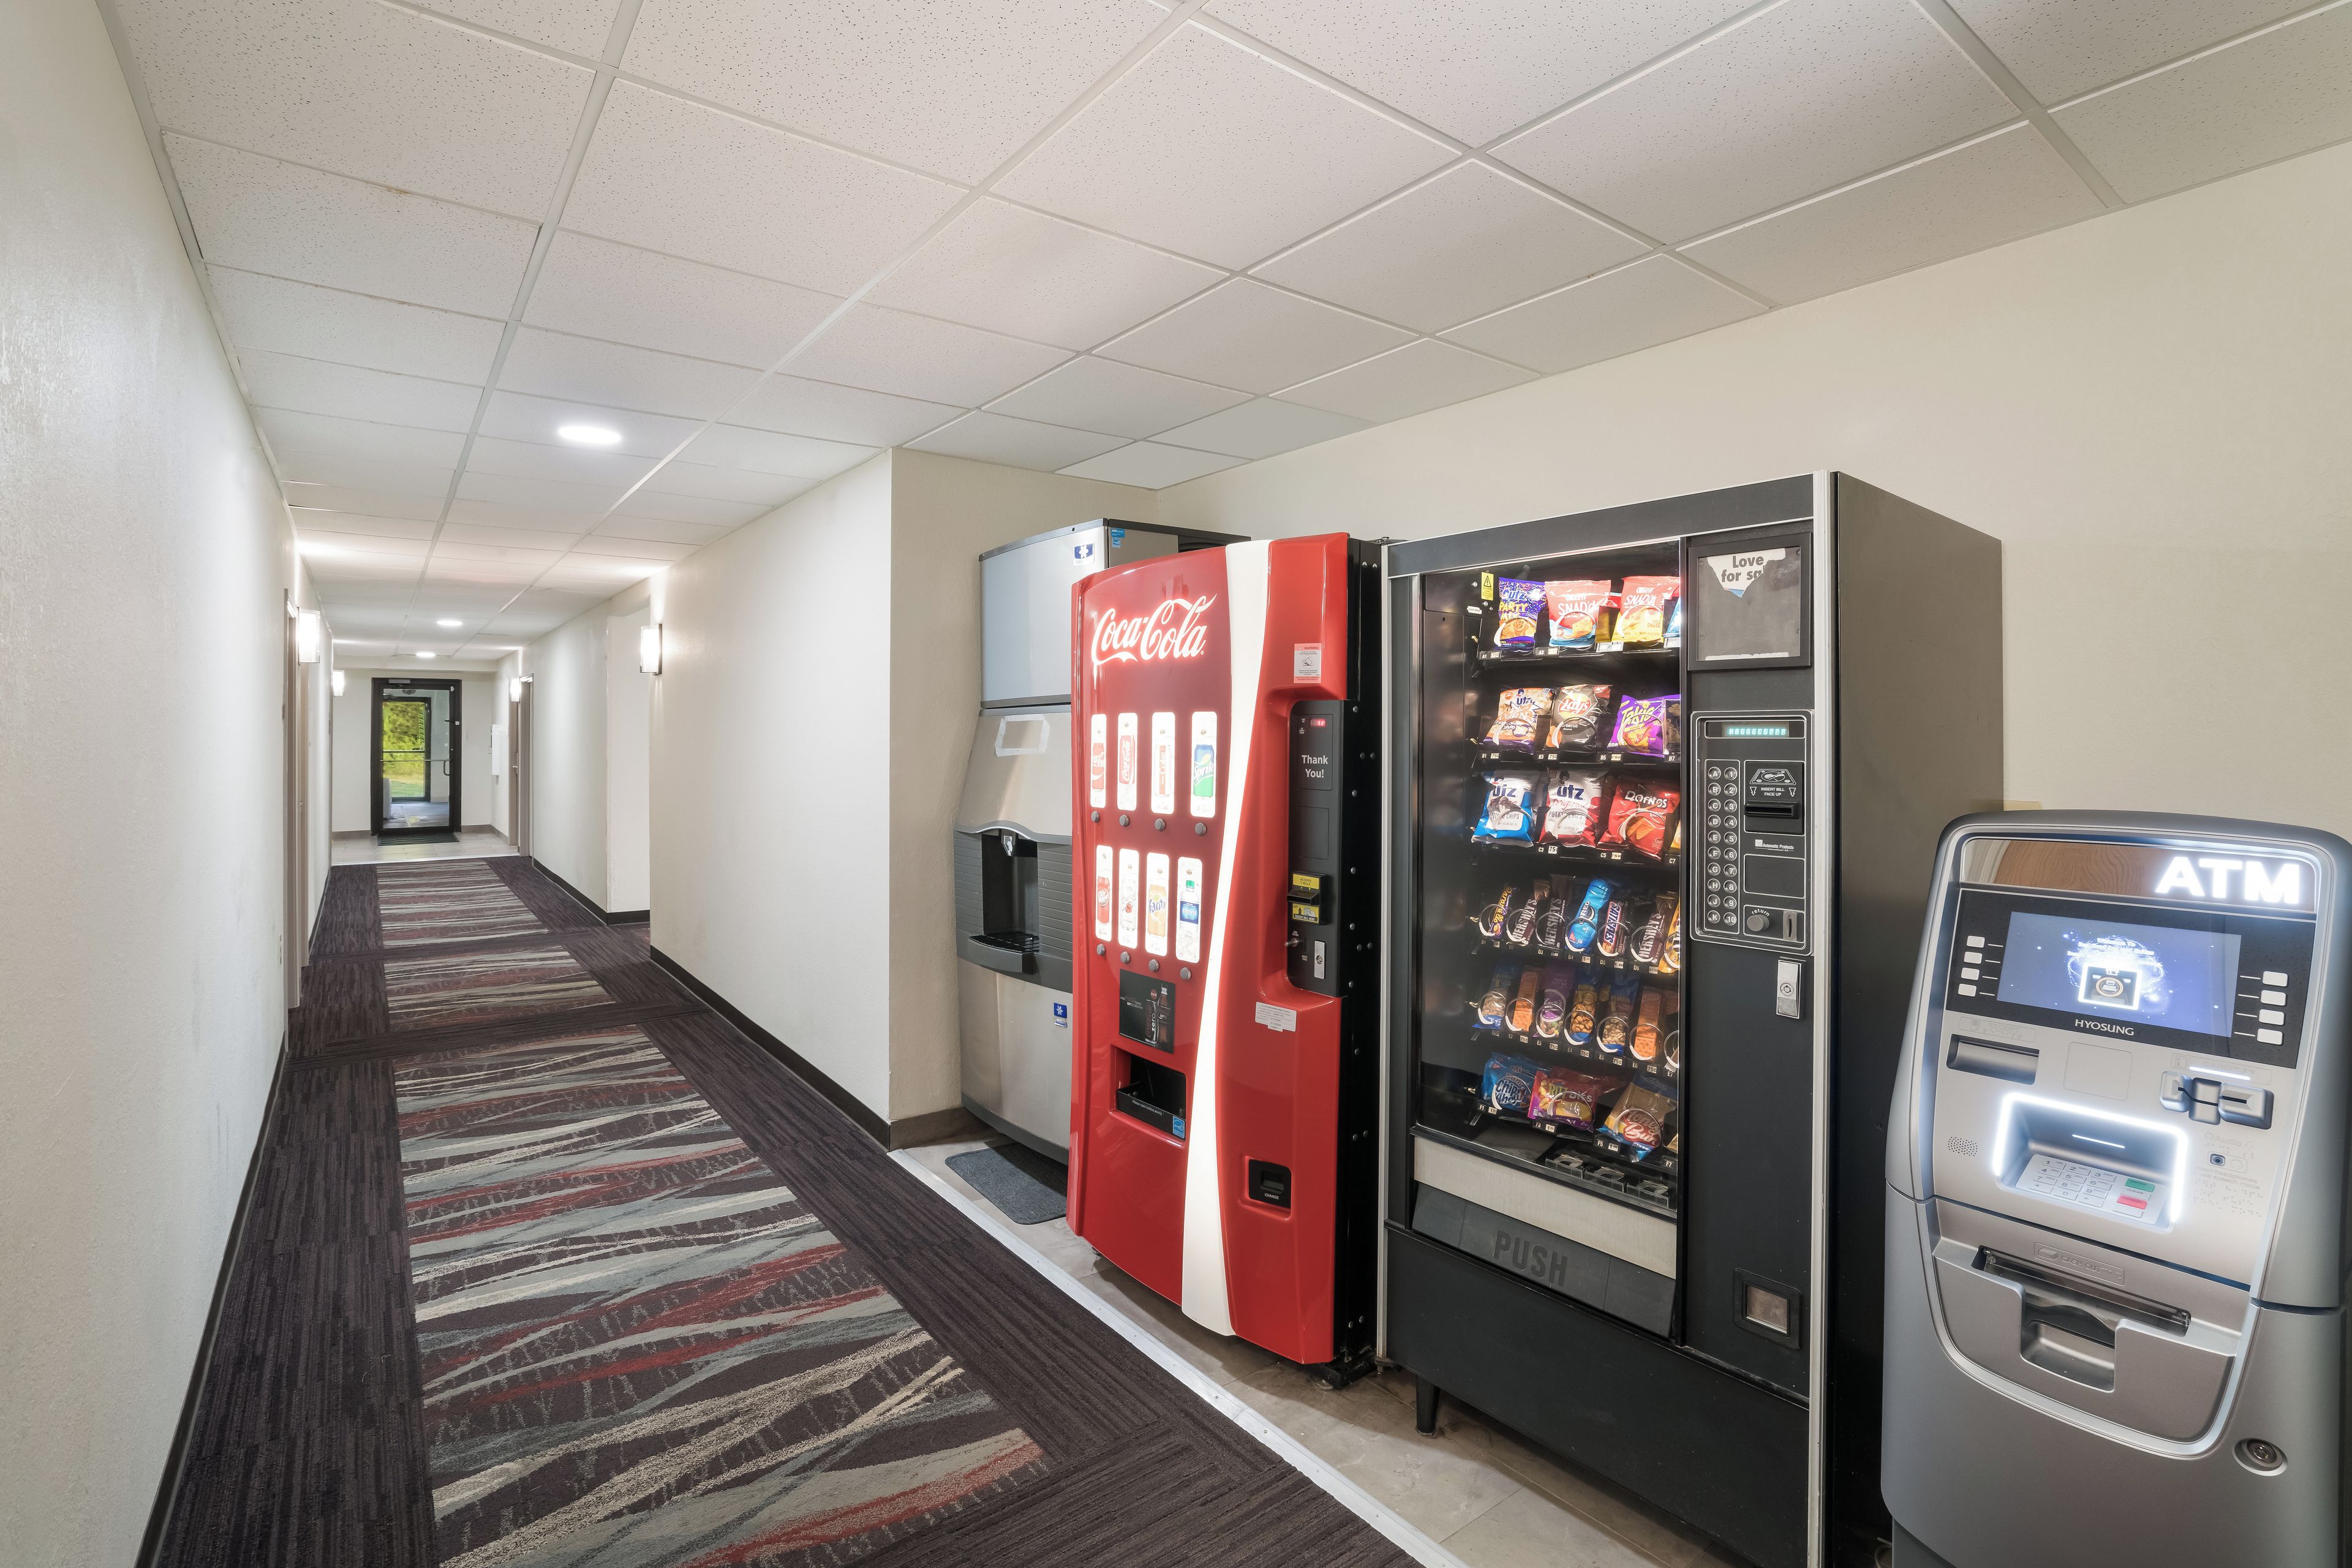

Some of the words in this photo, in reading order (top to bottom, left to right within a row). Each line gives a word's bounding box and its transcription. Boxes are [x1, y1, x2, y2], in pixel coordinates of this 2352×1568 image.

[1733, 556, 1764, 568] Love
[1721, 569, 1741, 582] for
[1499, 601, 1528, 612] PARTY
[1091, 593, 1217, 665] Coca-Cola
[1302, 755, 1328, 764] Thank
[1305, 769, 1324, 778] You!
[1625, 790, 1668, 808] Doritos
[2155, 856, 2301, 905] ATM
[2074, 1019, 2135, 1036] HYOSUNG
[1624, 1122, 1656, 1145] Bun
[2215, 1135, 2242, 1147] Audio
[1493, 1229, 1569, 1287] PUSH
[2061, 1255, 2082, 1268] CASH
[2084, 1264, 2101, 1273] OUT
